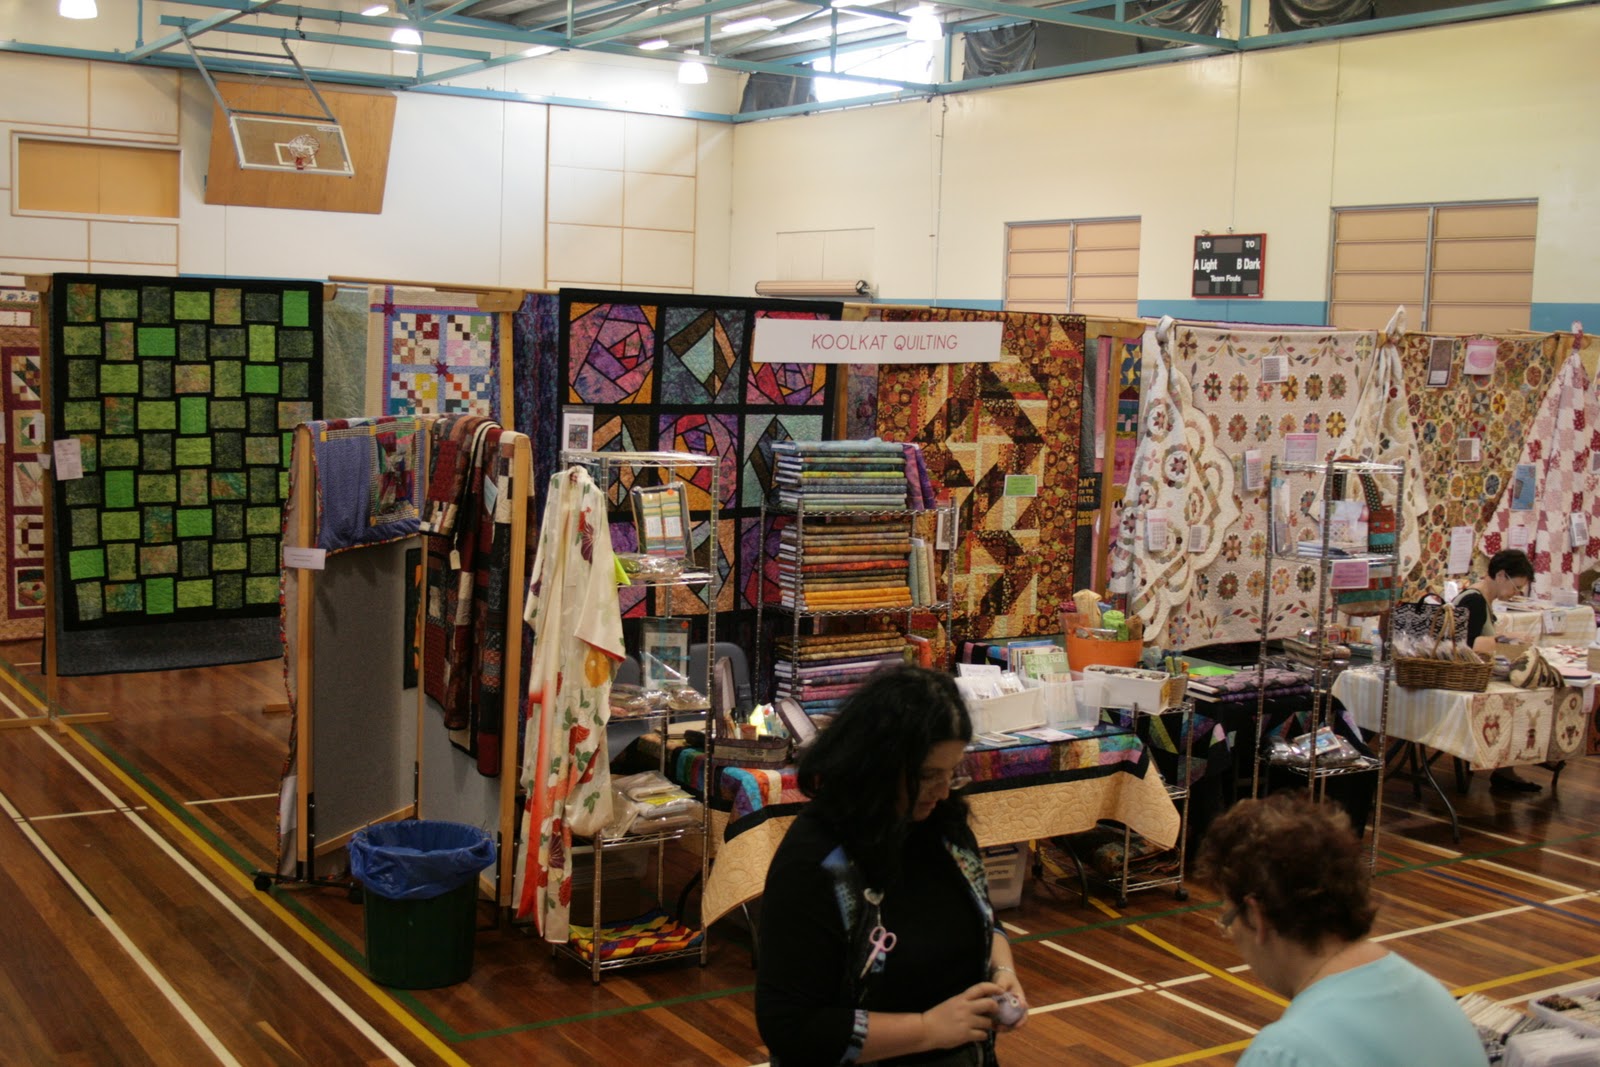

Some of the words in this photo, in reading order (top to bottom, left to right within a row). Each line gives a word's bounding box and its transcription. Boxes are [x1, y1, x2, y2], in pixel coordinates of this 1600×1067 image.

[1194, 259, 1200, 270] A
[1201, 259, 1218, 273] Light
[1236, 258, 1243, 270] B
[1243, 258, 1261, 270] Dark
[1210, 274, 1226, 282] Team
[1226, 274, 1241, 282] Fouls
[812, 334, 887, 350] KOOLKAT
[893, 334, 958, 351] QUILTING
